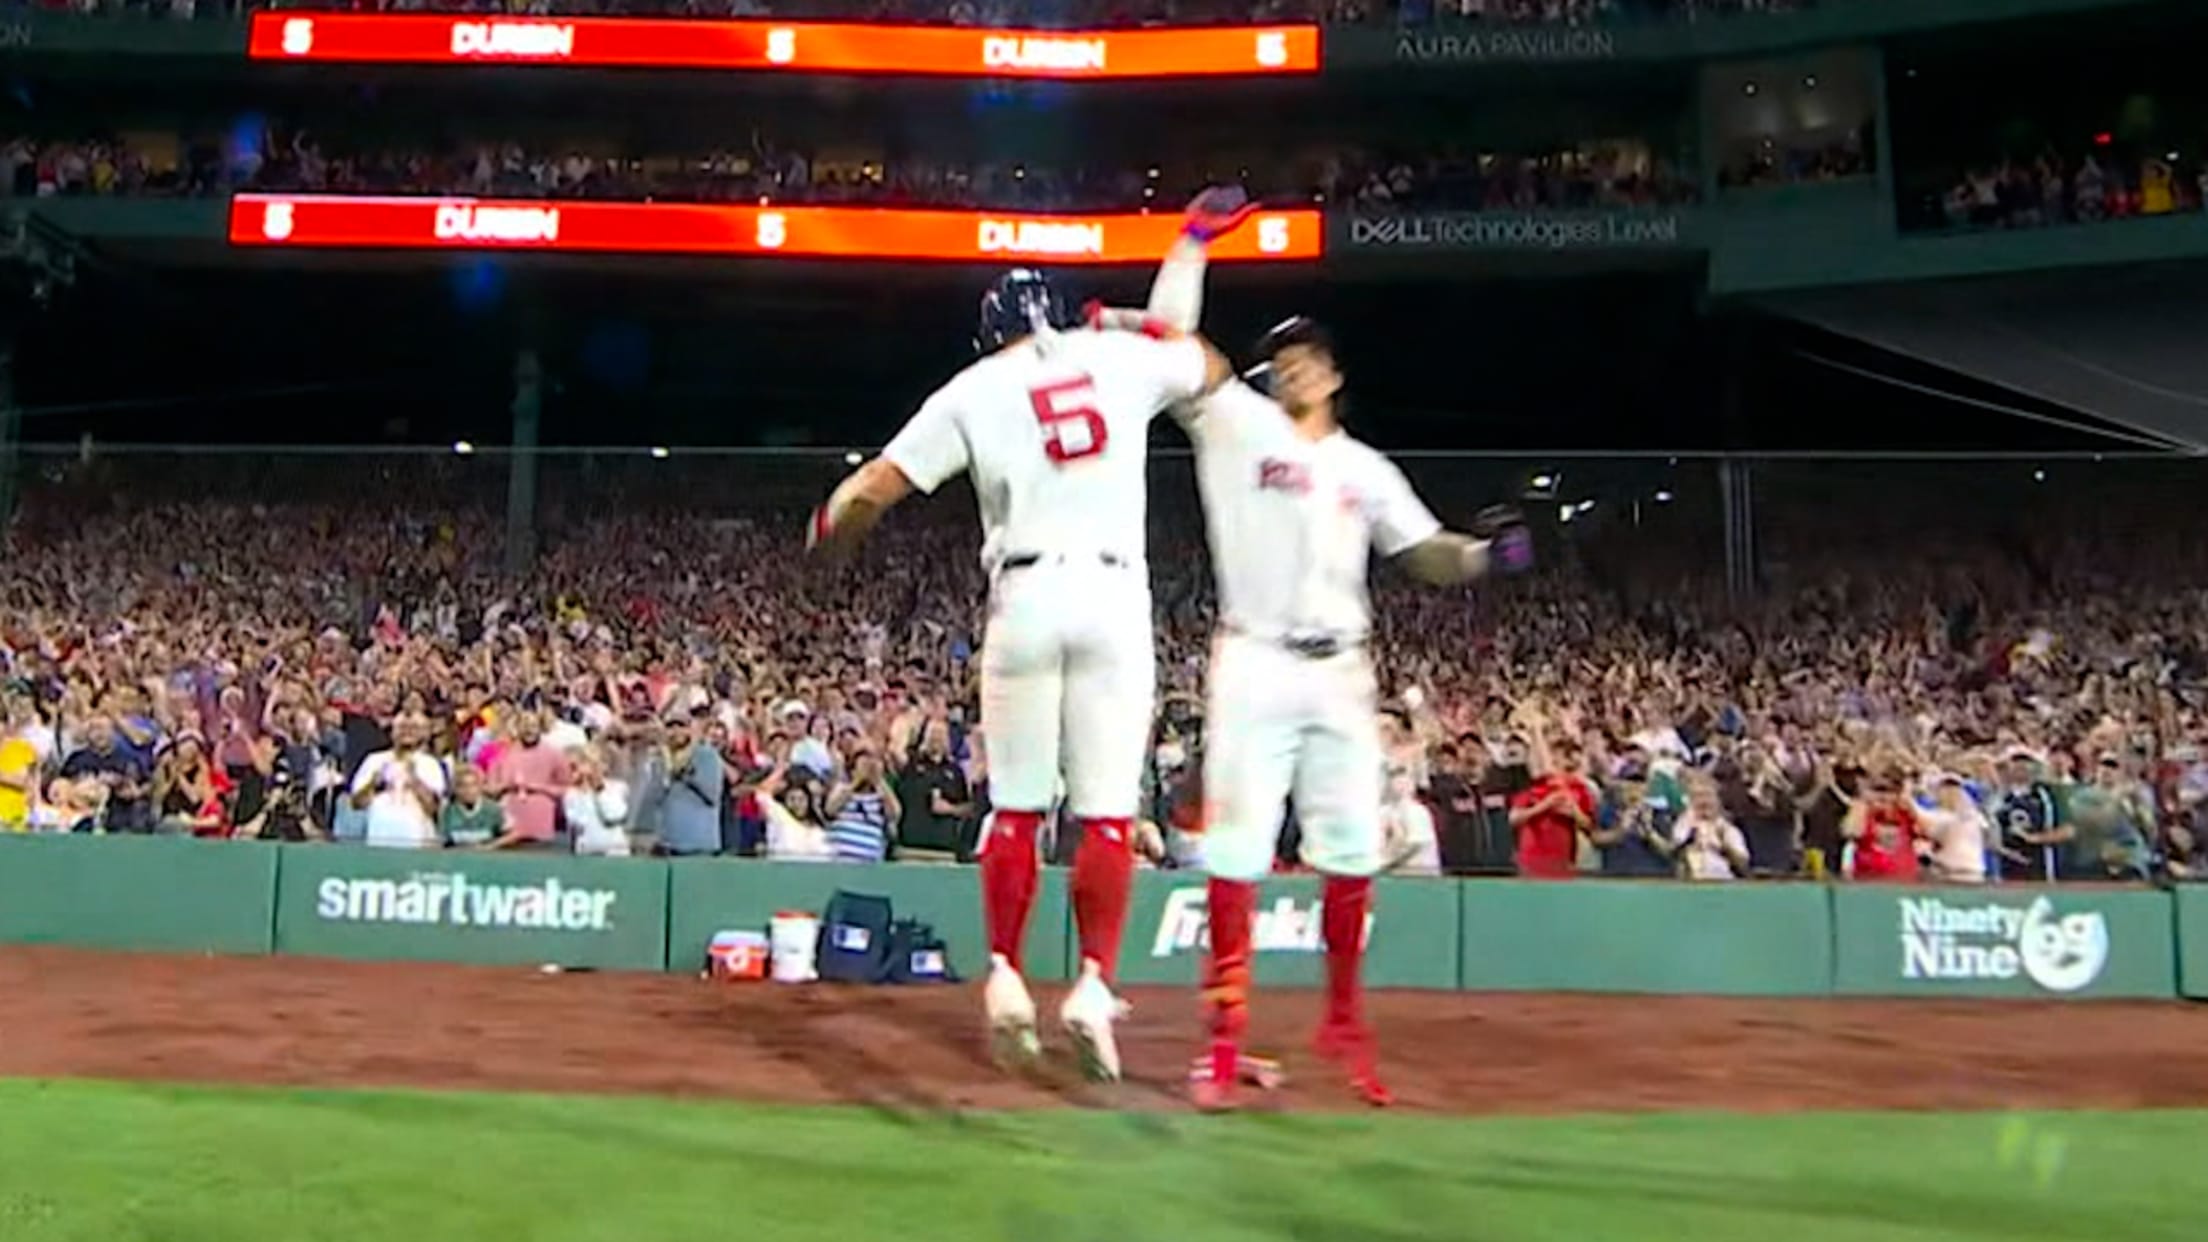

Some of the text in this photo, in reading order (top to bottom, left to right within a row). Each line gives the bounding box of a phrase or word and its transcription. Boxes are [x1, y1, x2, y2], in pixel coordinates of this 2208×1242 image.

[283, 19, 311, 54] 5
[768, 29, 794, 63] 5
[1257, 32, 1286, 66] 5
[1490, 31, 1614, 57] PAVILION
[264, 205, 292, 238] 5
[758, 214, 784, 248] 5
[1259, 218, 1287, 252] 5
[1606, 215, 1677, 242] Level
[1030, 373, 1108, 466] 5
[316, 873, 617, 929] smartwater
[1899, 897, 2024, 940] Ninety
[1901, 935, 2020, 979] Nine
